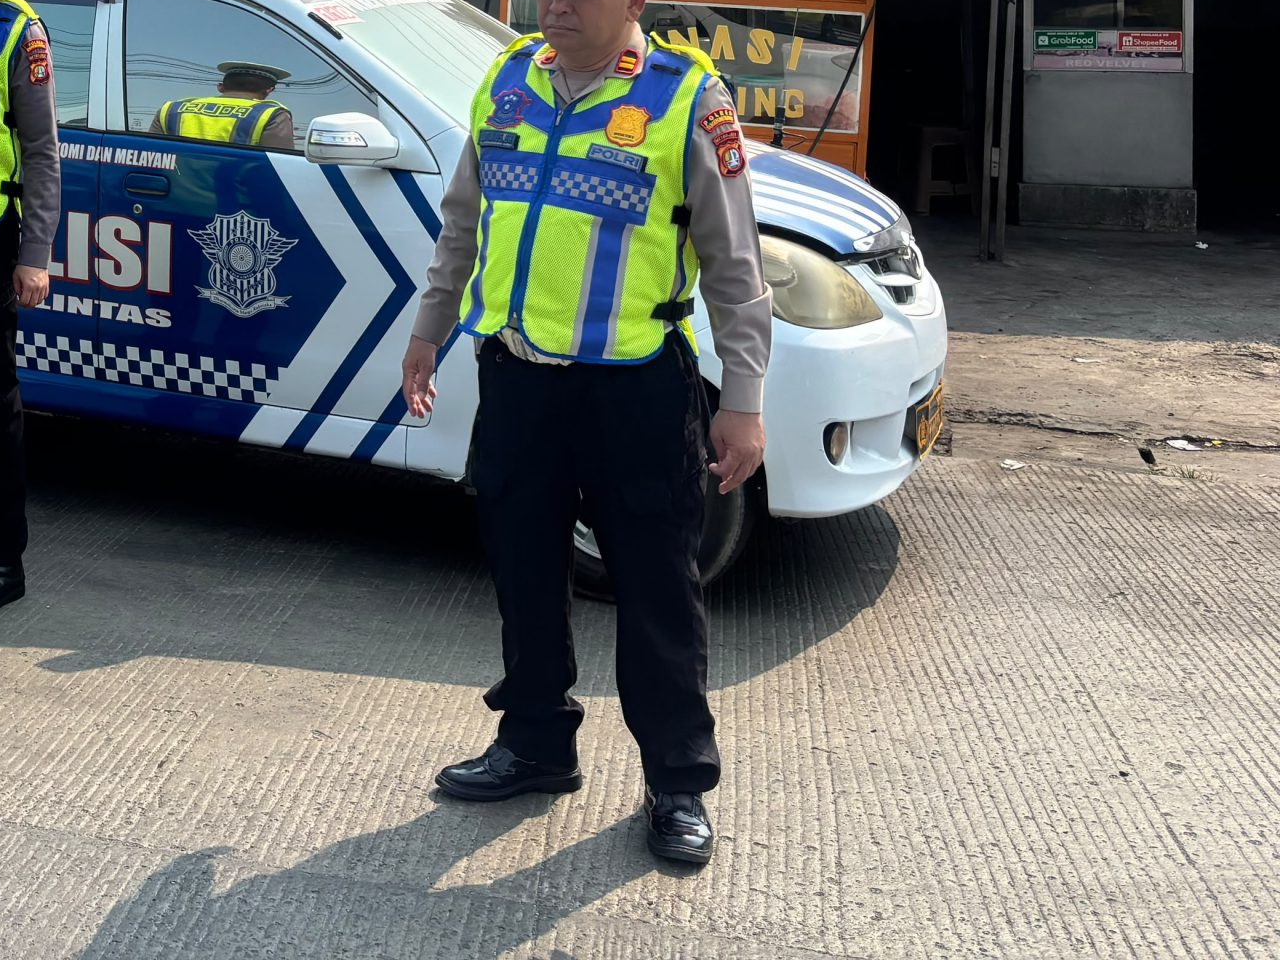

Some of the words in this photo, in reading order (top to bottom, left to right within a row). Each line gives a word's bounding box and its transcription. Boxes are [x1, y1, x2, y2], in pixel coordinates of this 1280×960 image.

[667, 25, 804, 71] NASI
[1050, 36, 1094, 45] GrabFood
[1133, 38, 1178, 47] ShopeeFood
[1065, 58, 1092, 68] RED
[736, 86, 805, 119] ING
[86, 145, 111, 162] DAN
[115, 148, 177, 170] MELAYANI
[591, 146, 642, 168] POLRI
